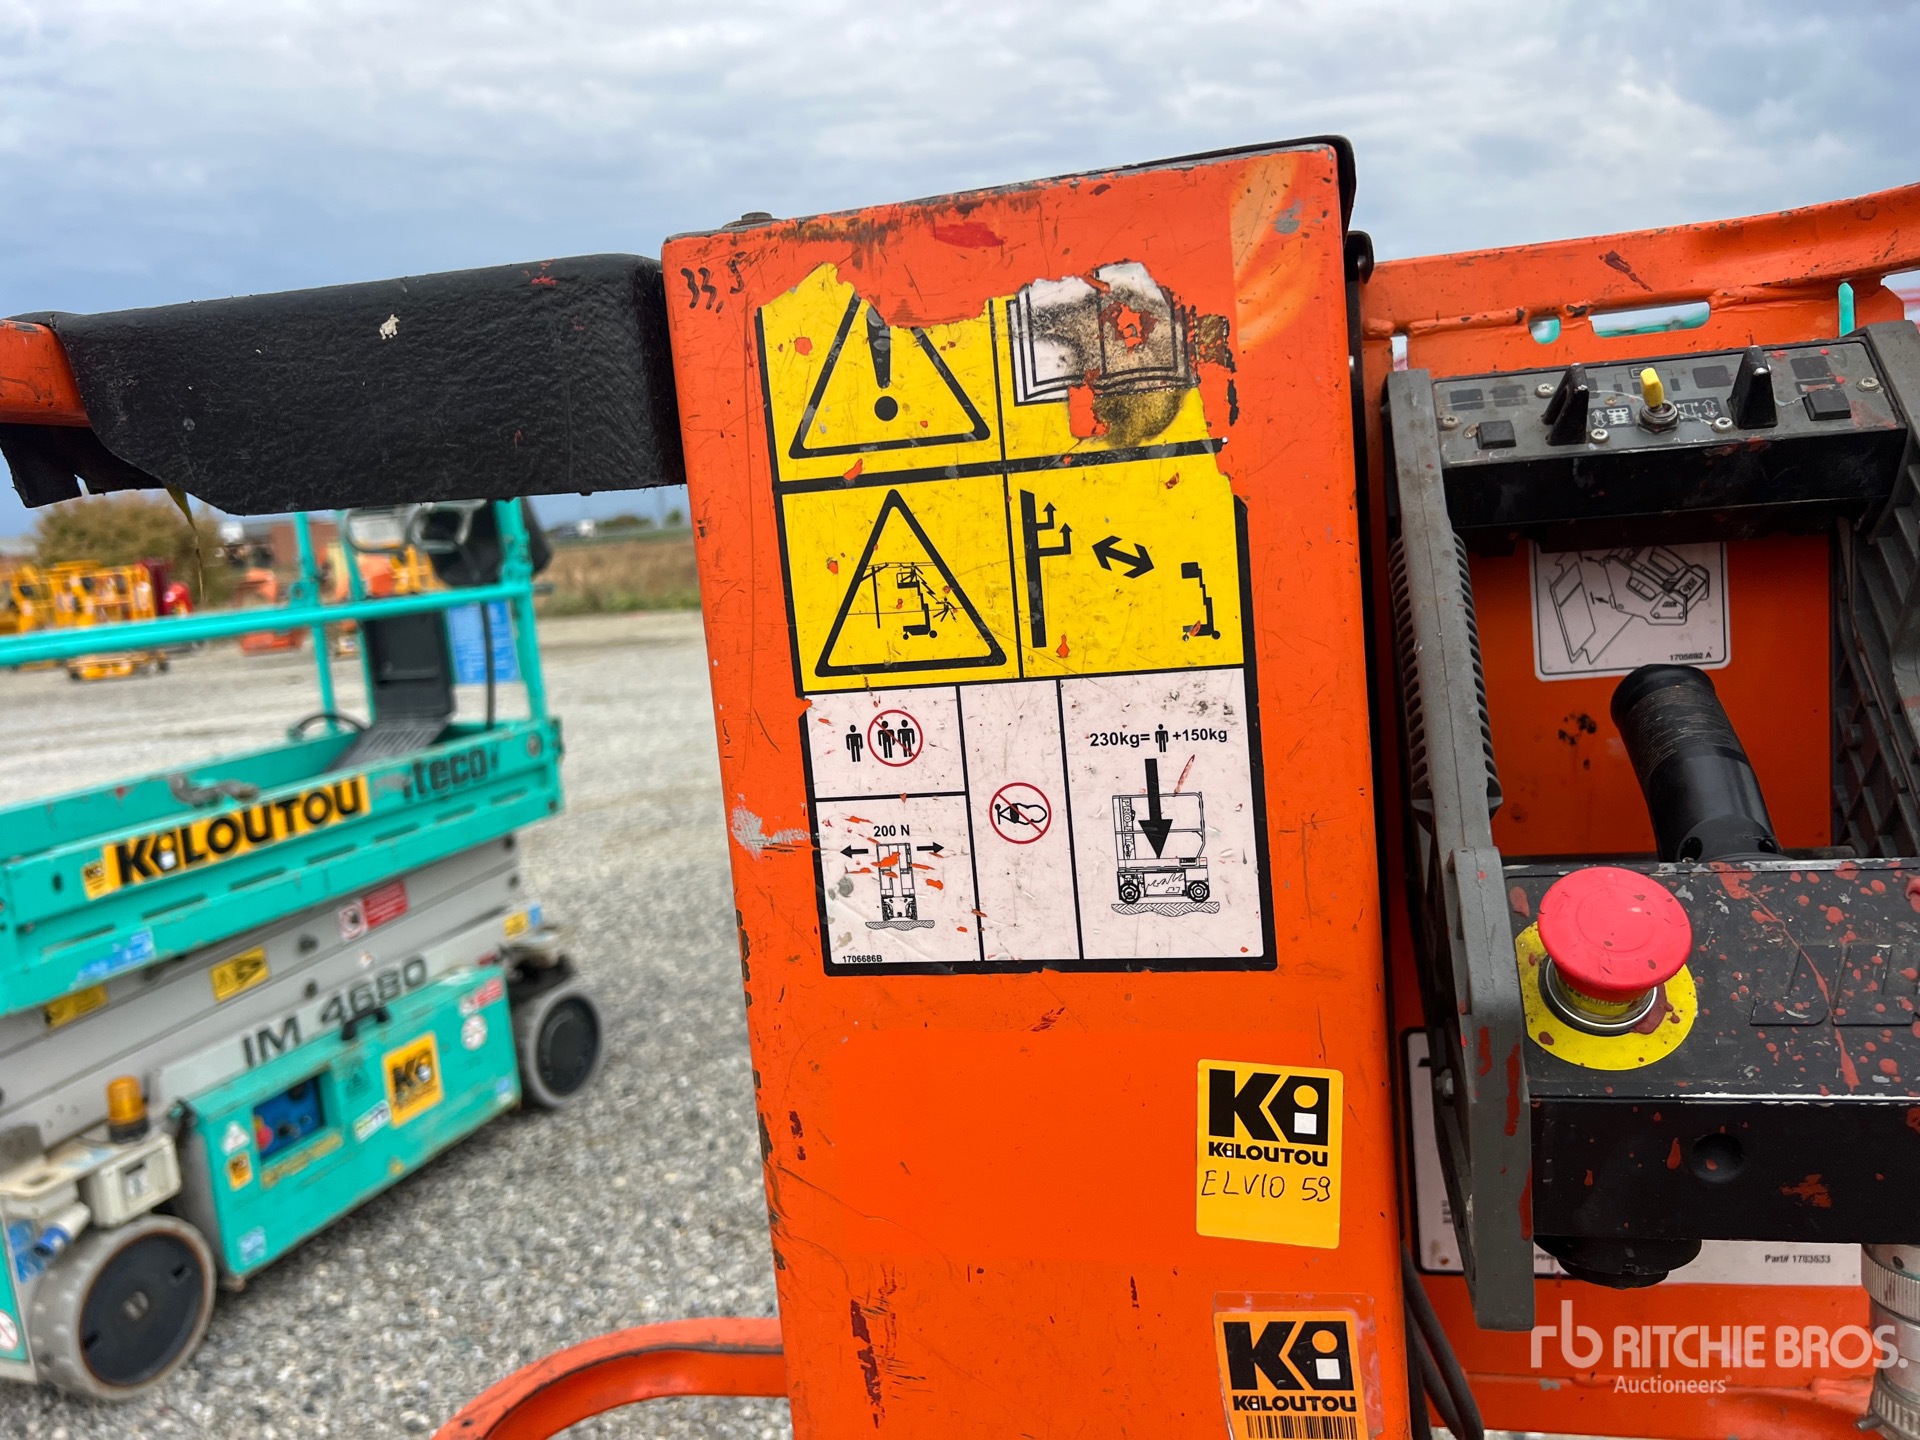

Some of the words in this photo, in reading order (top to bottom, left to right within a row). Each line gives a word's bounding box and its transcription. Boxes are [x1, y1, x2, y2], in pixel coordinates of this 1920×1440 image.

[1089, 731, 1151, 748] 230kg=
[1172, 728, 1228, 743] +150kg
[873, 825, 897, 837] 200
[900, 824, 910, 837] N
[241, 1016, 302, 1068] IM
[1201, 1170, 1286, 1198] ELVIO
